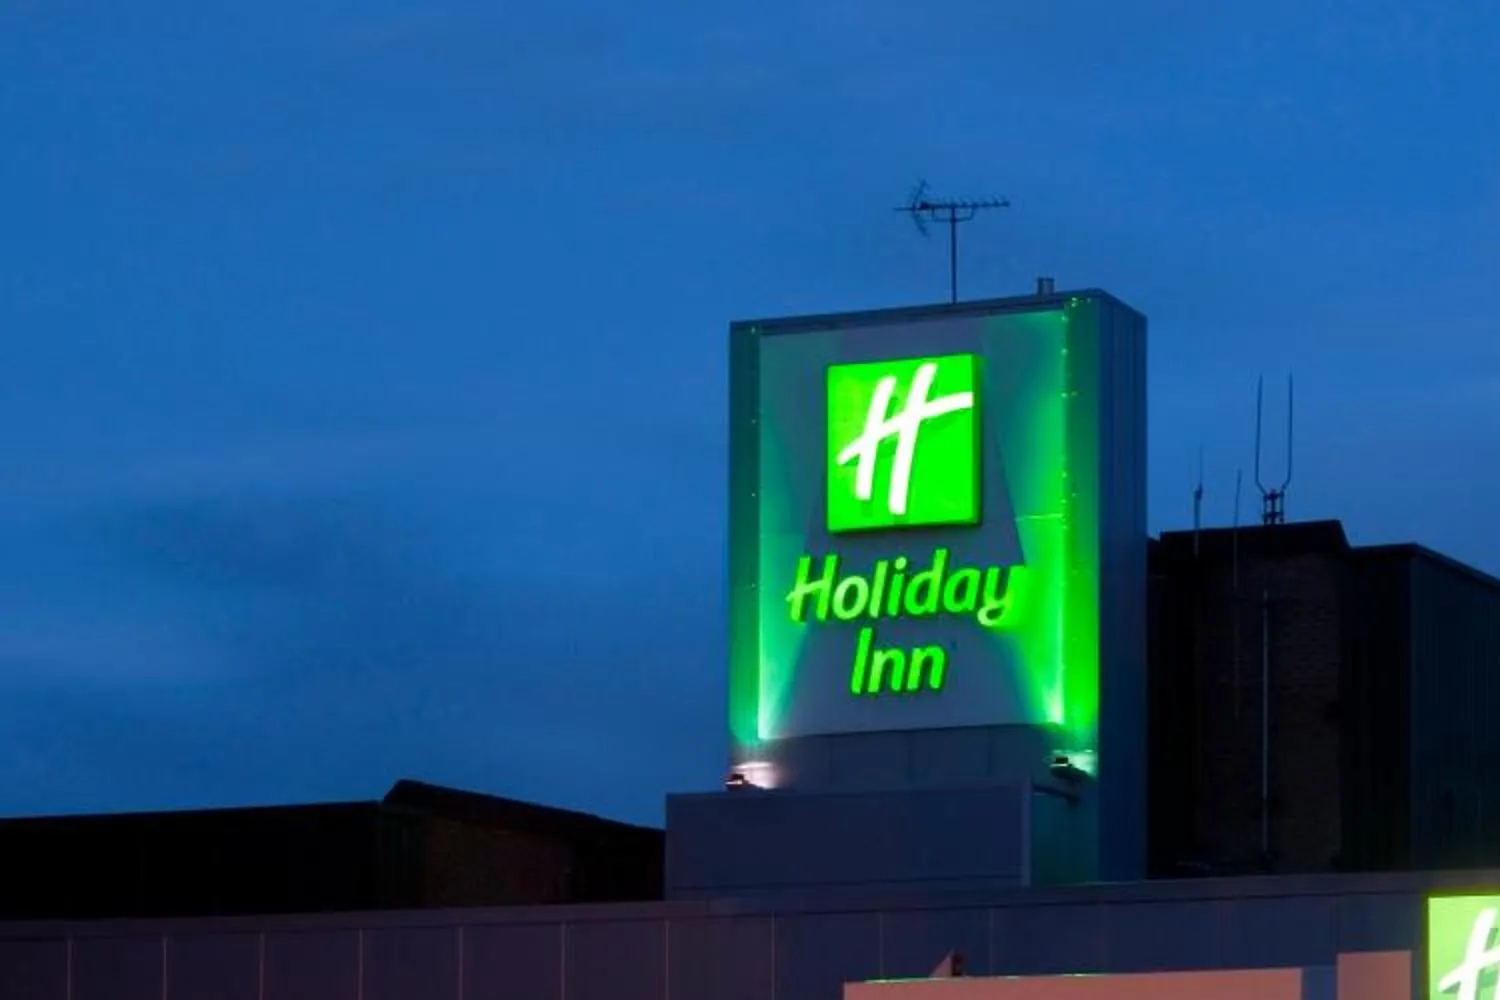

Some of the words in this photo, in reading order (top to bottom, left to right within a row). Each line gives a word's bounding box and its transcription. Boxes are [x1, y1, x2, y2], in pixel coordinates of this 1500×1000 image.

[837, 363, 974, 515] H
[785, 548, 1017, 626] Holiday
[850, 626, 946, 694] Inn
